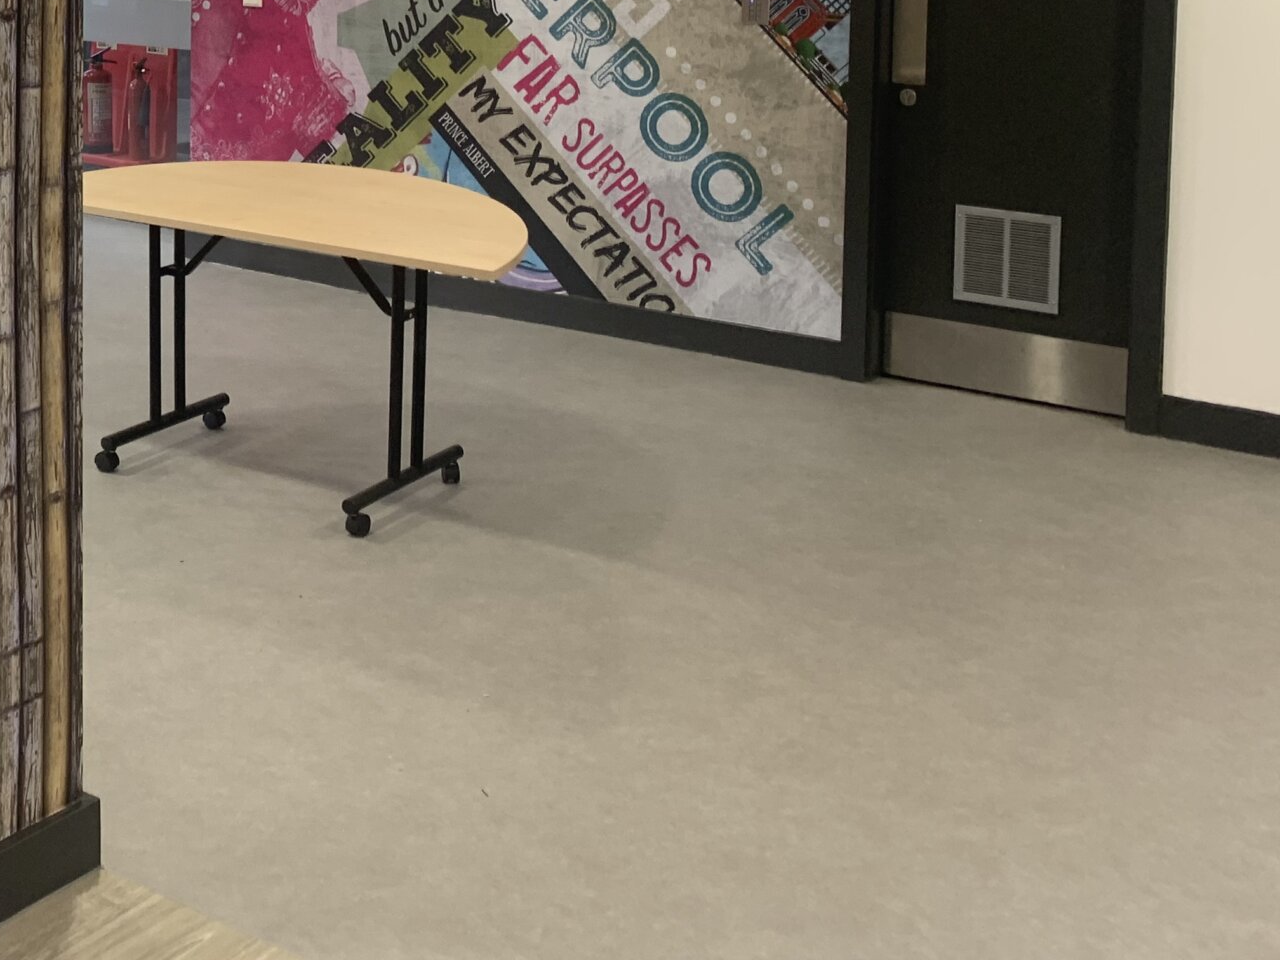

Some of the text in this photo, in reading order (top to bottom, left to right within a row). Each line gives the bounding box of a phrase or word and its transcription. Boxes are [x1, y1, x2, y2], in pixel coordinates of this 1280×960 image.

[458, 75, 514, 123] MY
[437, 111, 496, 179] PRINCE ALBERT
[496, 34, 712, 288] FAR SURPASSES
